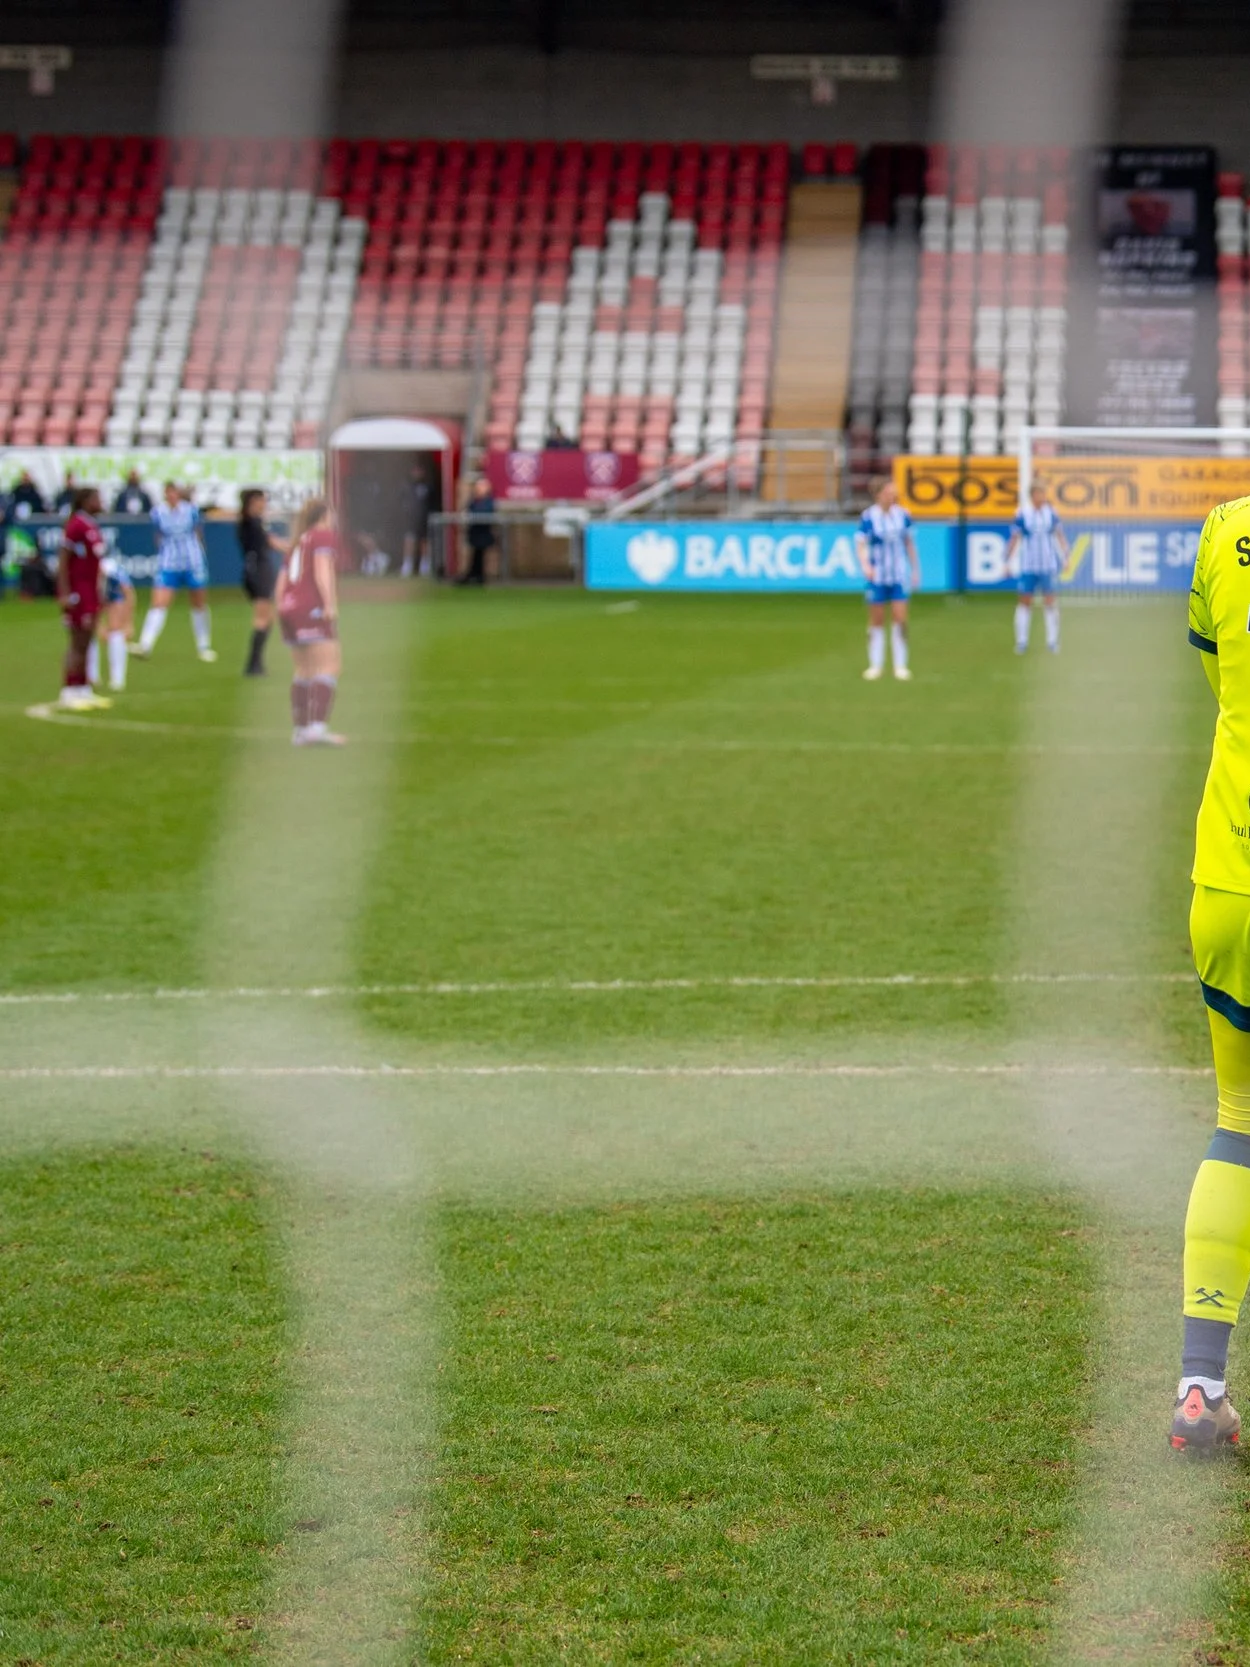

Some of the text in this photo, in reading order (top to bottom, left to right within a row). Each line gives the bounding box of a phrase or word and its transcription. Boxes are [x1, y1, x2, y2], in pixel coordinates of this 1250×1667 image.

[906, 465, 1139, 507] boson
[683, 533, 861, 580] BARCLA
[966, 530, 1160, 585] BYLE
